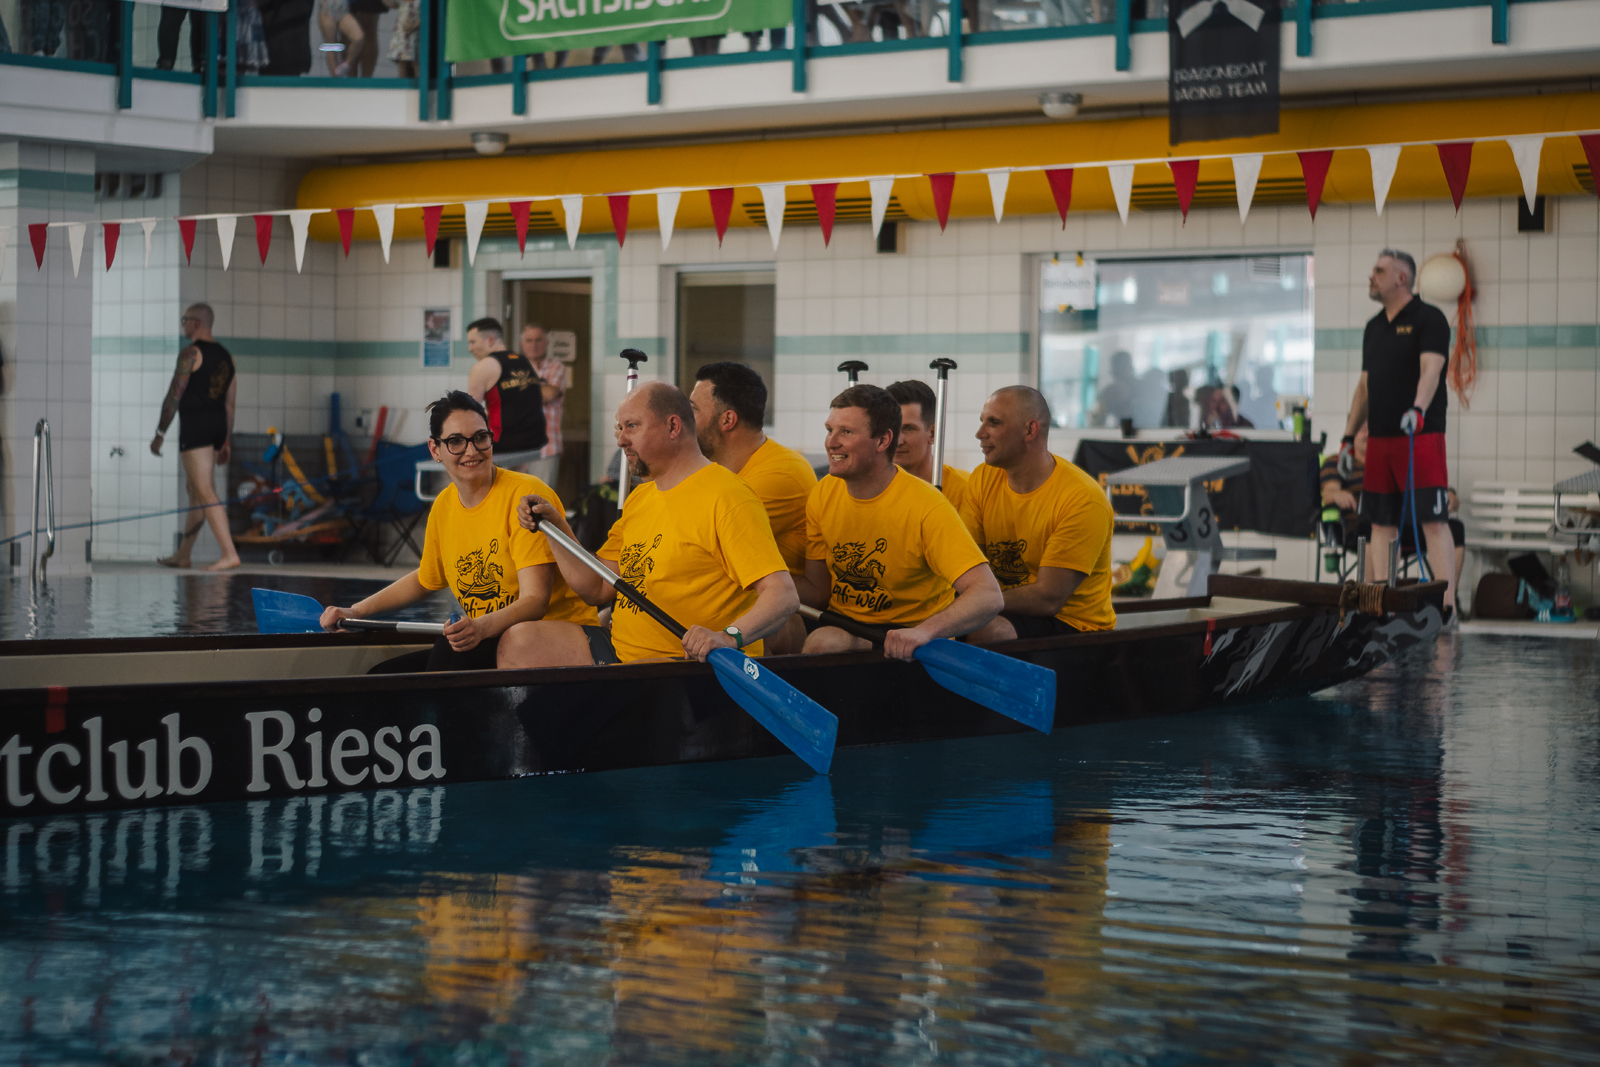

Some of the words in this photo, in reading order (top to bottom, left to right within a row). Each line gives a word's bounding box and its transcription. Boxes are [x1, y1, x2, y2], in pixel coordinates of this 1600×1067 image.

[1227, 80, 1268, 97] TEAM
[1197, 507, 1211, 539] 3
[244, 707, 448, 793] Riesa
